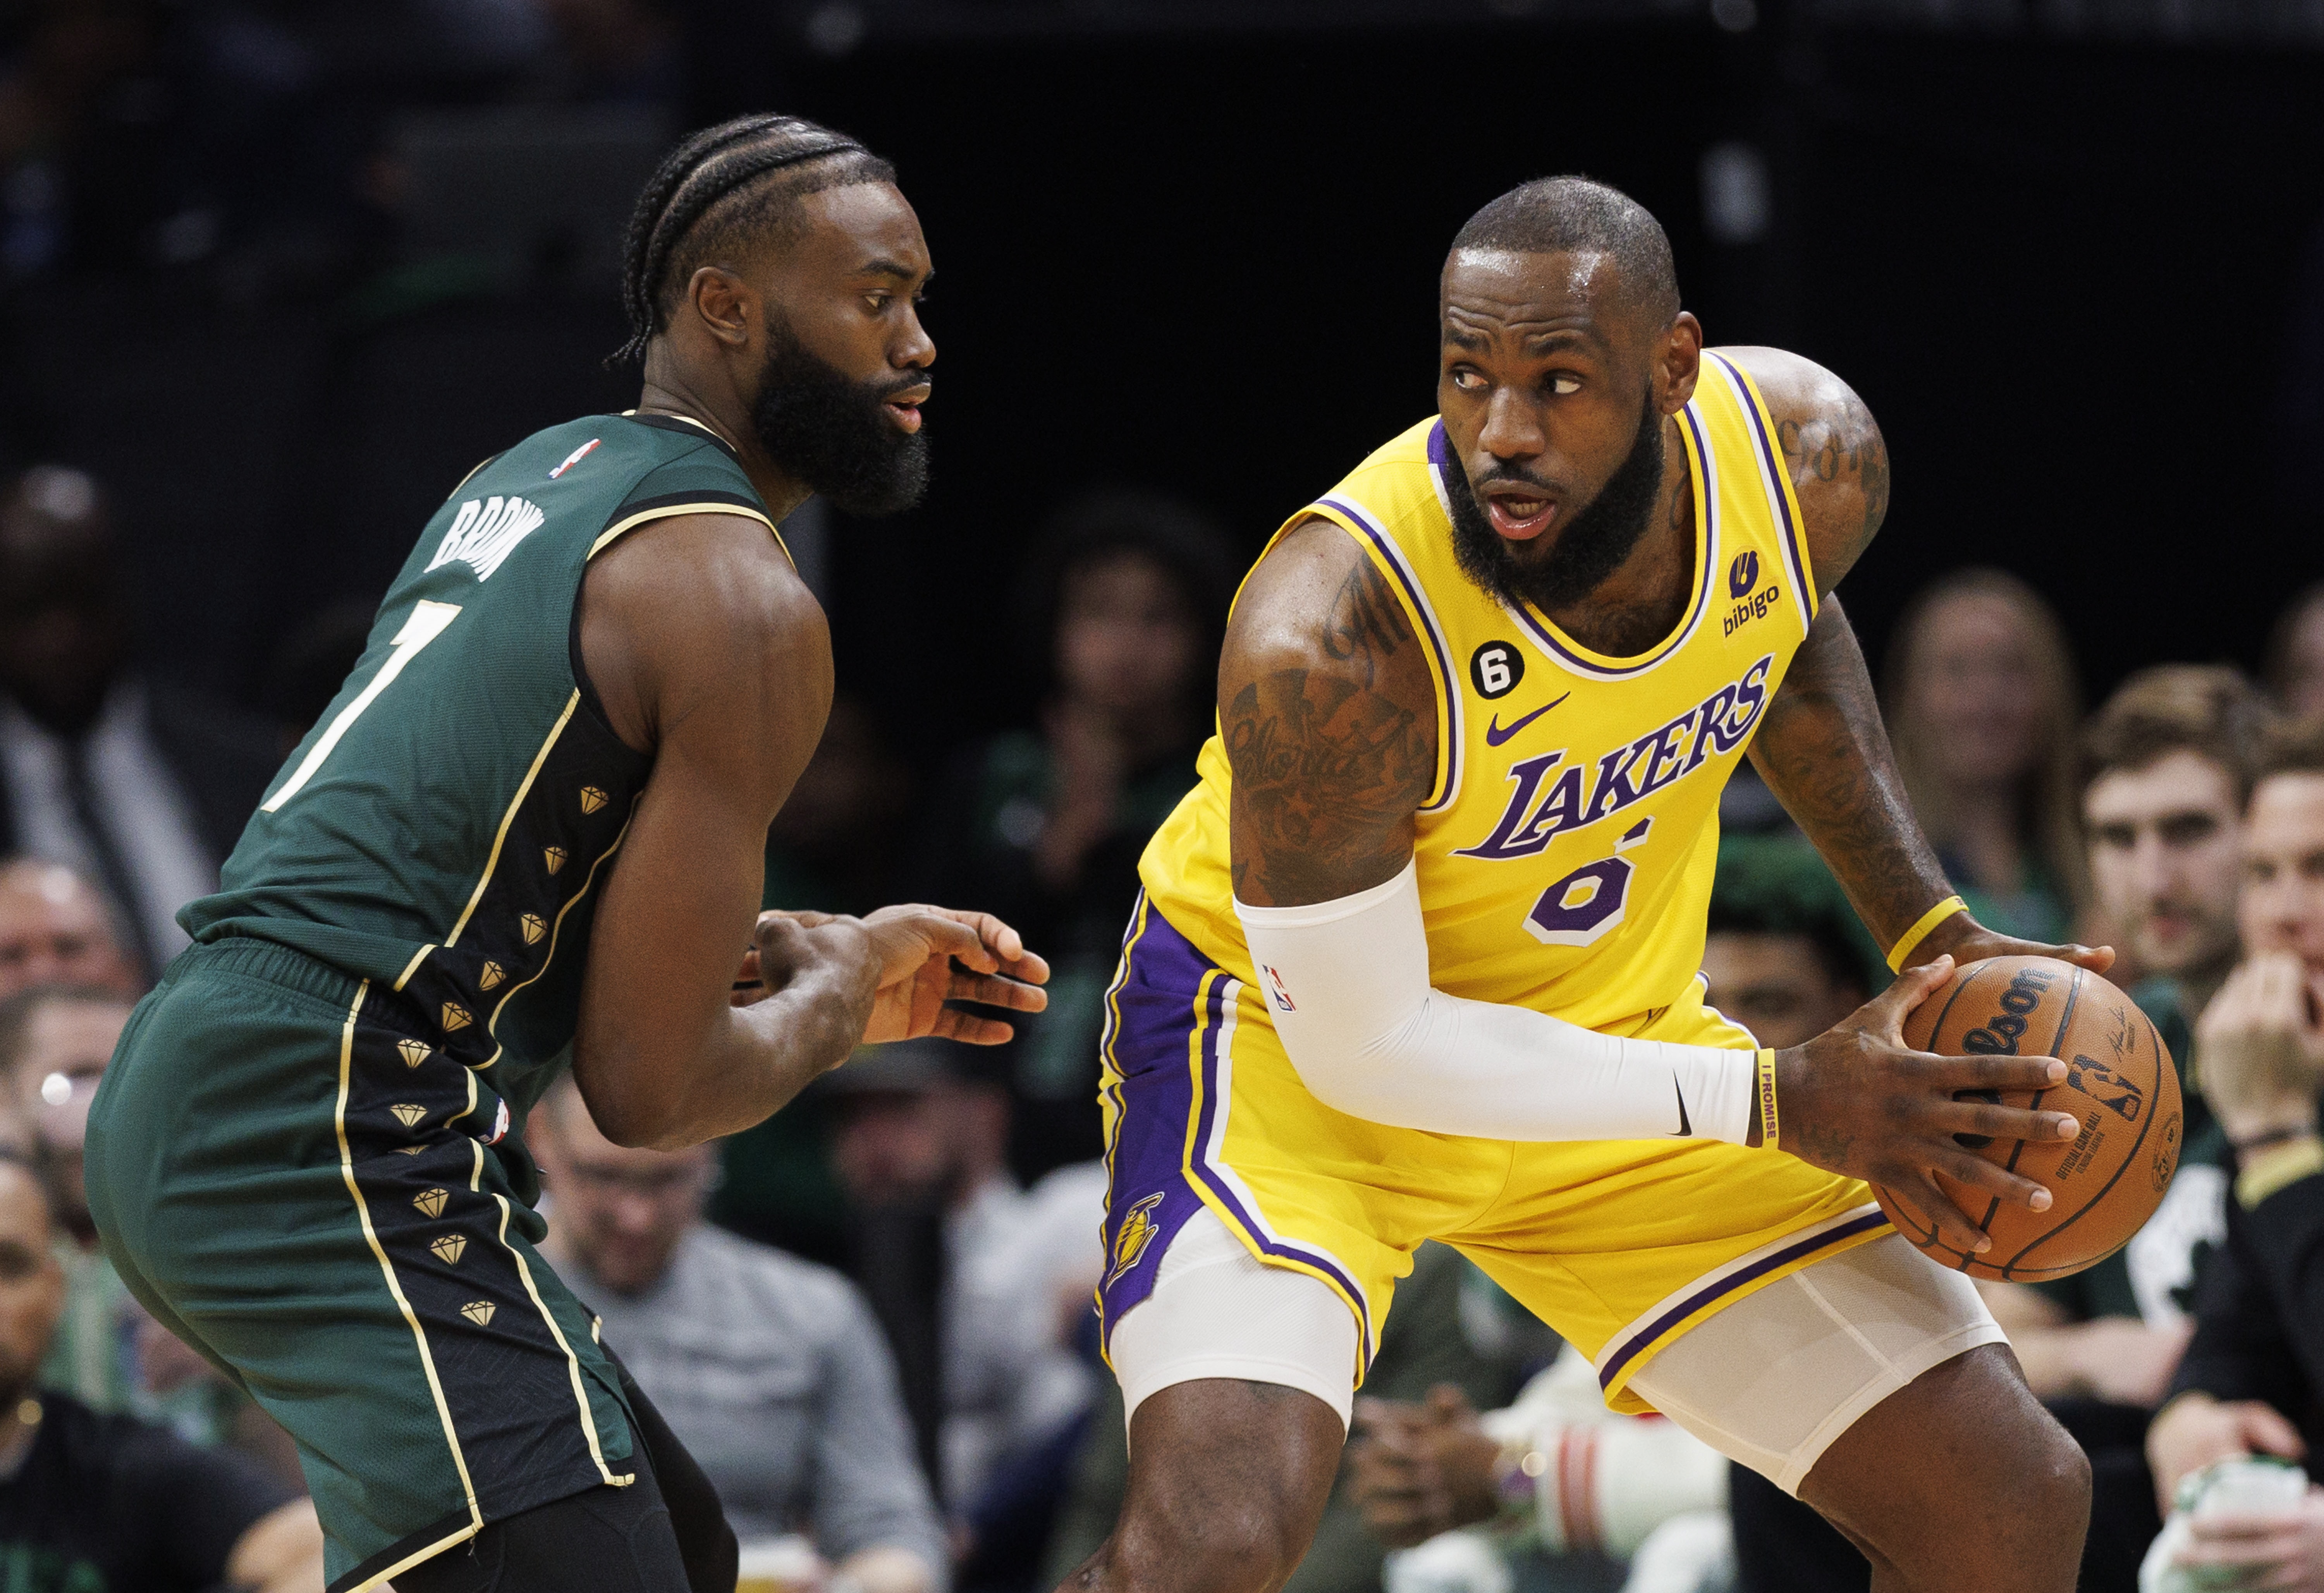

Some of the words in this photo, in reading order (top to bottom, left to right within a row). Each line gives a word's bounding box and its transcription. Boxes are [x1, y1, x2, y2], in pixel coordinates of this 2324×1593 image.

[1724, 585, 1779, 638] bibigo
[1479, 649, 1511, 693] 6
[1446, 652, 1776, 862] LAKERS
[1762, 1073, 1776, 1139] PROMISE
[2056, 1148, 2083, 1180] OFFICIAL
[2074, 1127, 2094, 1151] GAME
[2085, 1111, 2102, 1131] BALL
